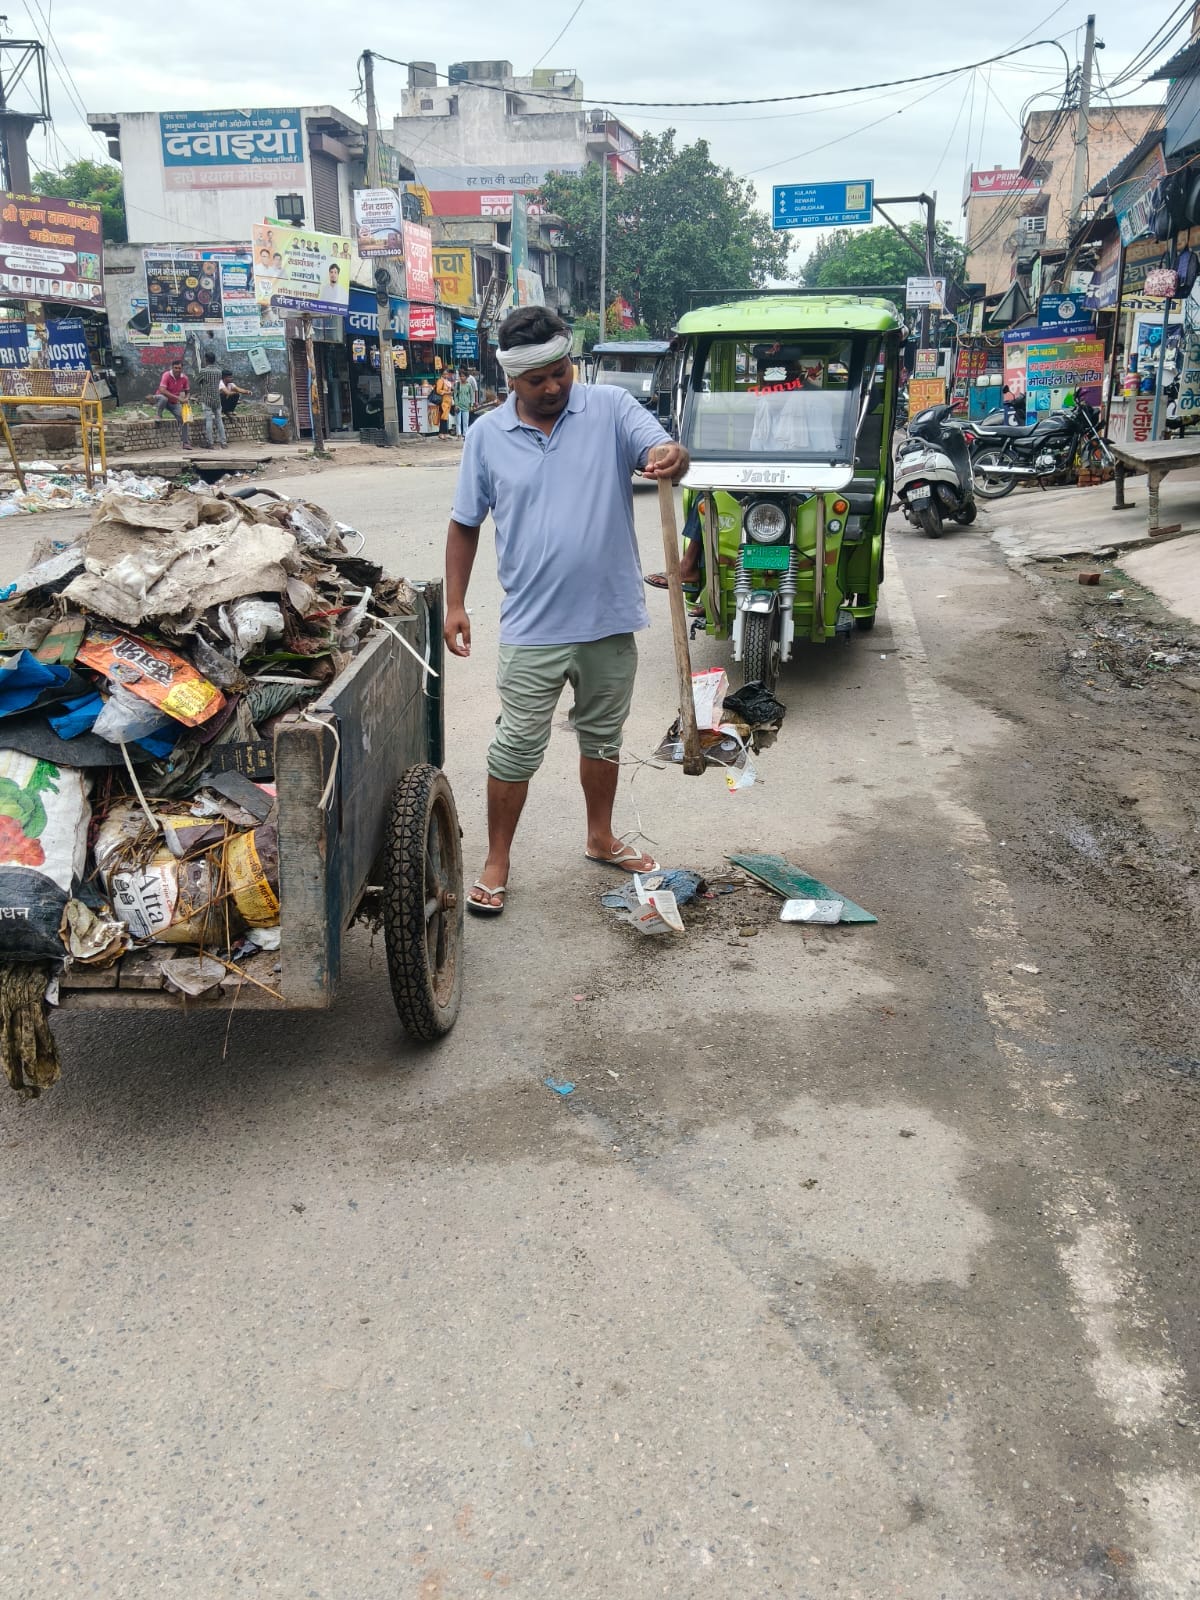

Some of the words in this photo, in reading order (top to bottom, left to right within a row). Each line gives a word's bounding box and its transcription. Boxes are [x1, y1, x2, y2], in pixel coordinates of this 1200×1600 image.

[741, 468, 787, 484] Yatri
[139, 875, 165, 924] Atta
[0, 907, 30, 920] धन
